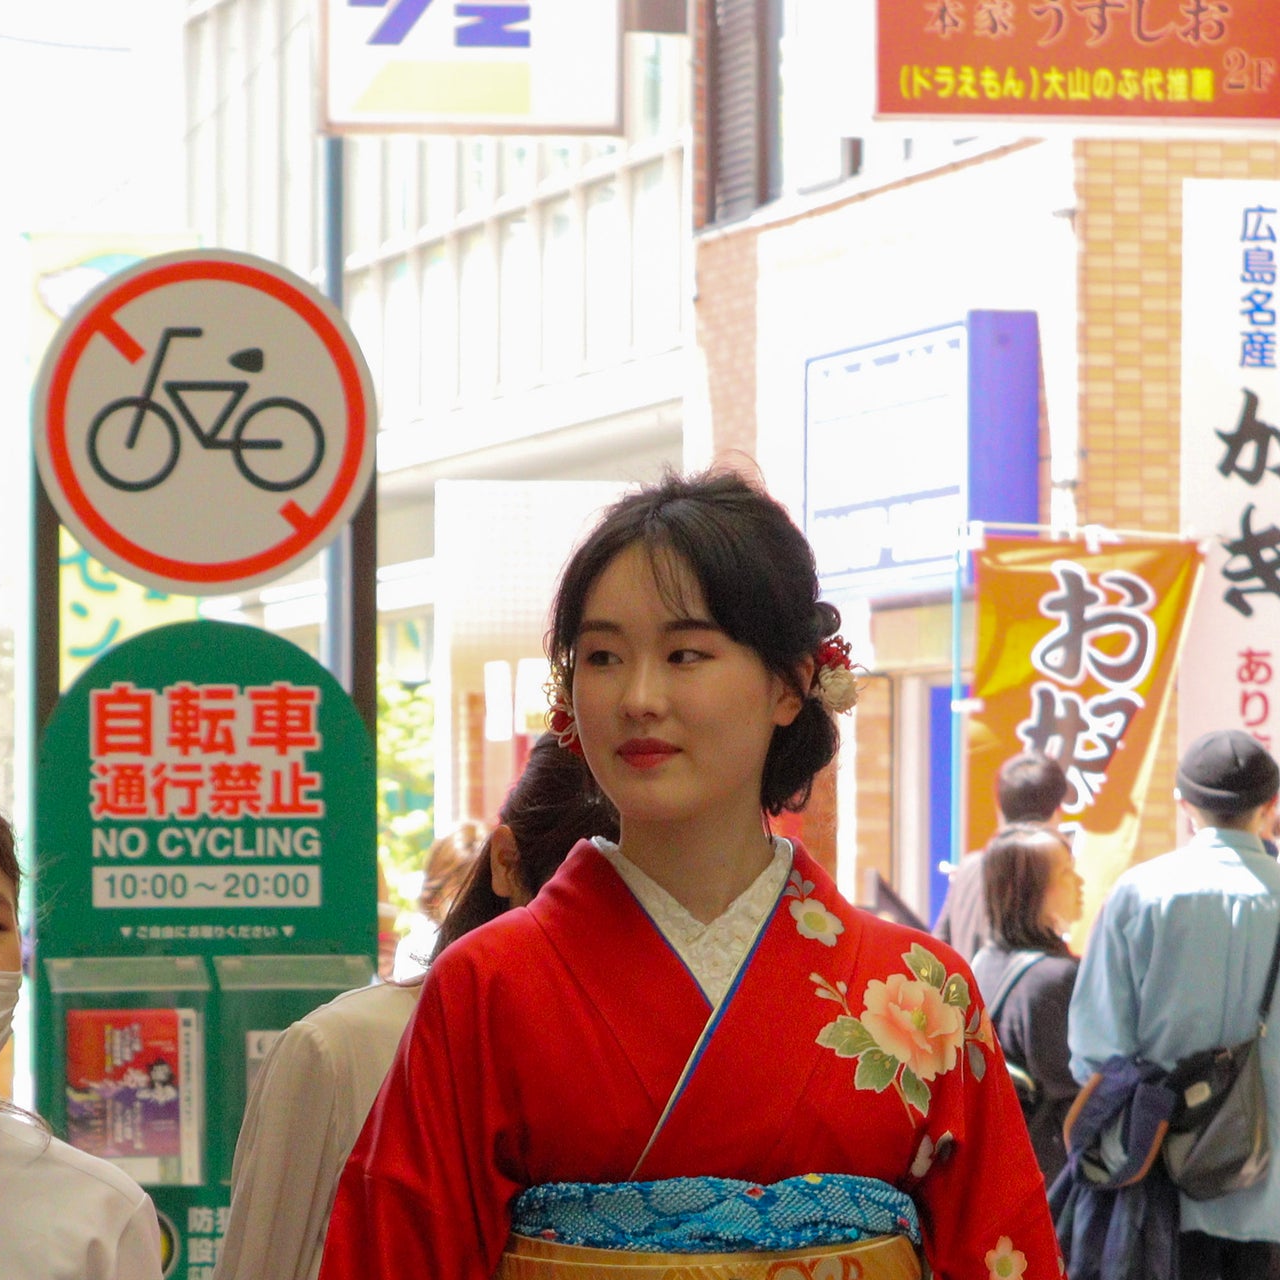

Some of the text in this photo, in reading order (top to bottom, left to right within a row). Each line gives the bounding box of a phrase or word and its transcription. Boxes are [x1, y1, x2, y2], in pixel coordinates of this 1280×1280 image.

[1239, 205, 1278, 368] 広島名産
[91, 683, 320, 757] 自転車
[92, 761, 322, 817] 通行禁止
[93, 827, 322, 858] NO CYCLING
